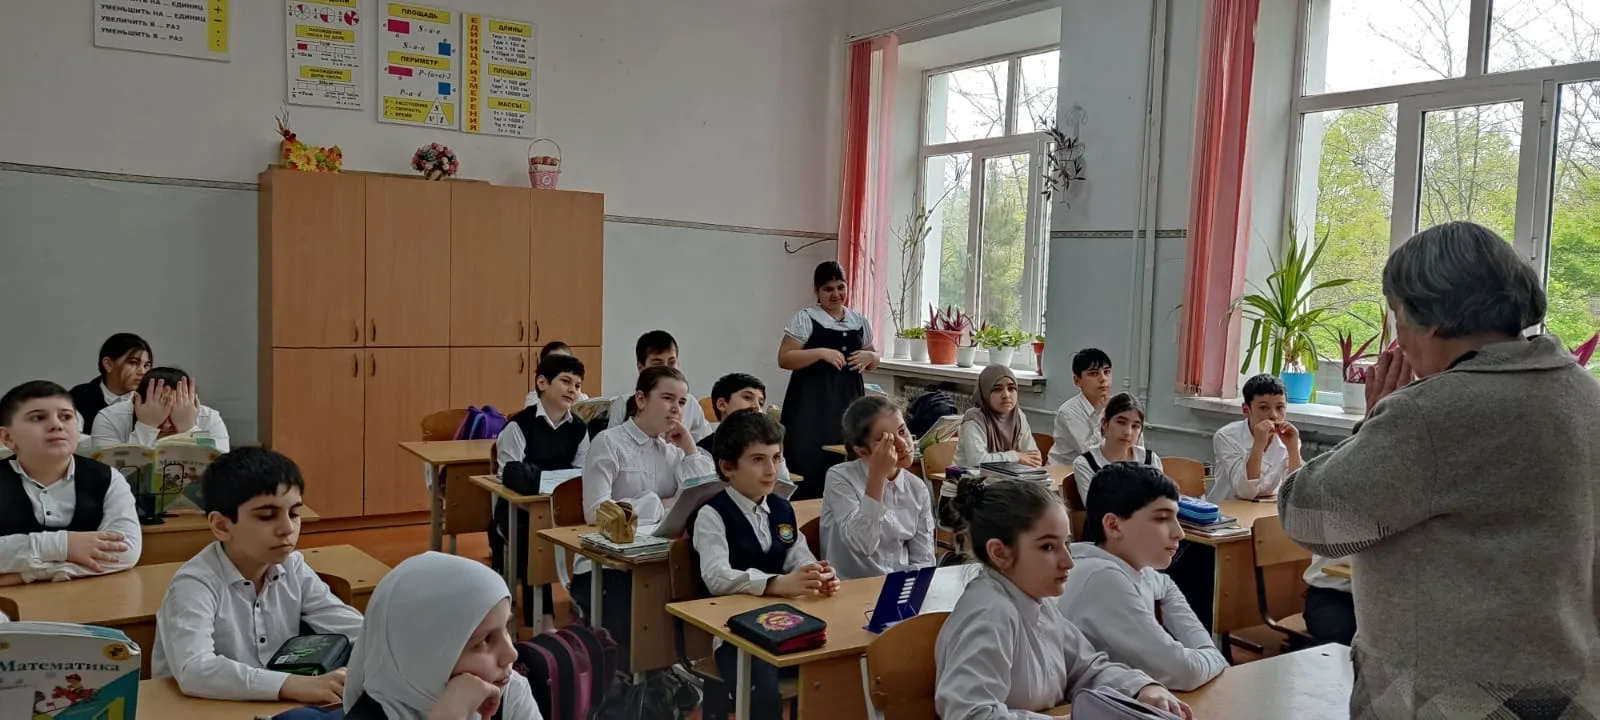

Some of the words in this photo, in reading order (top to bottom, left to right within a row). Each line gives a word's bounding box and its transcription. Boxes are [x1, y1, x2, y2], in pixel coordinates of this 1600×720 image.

[172, 2, 204, 10] ЕДИНИЦ
[101, 4, 150, 15] УМЕНЬШИТЬ
[174, 13, 206, 22] ЕДИНИЦ
[402, 8, 438, 19] ПЛОЩАДЬ
[101, 15, 148, 26] УВЕЛИЧИТЬ
[101, 27, 150, 38] УМЕНЬШИТЬ
[401, 56, 438, 65] ПЕРИМЕТР
[494, 68, 526, 76] ПЛОЩАДИ
[470, 69, 478, 130] ИЗМЕРЕНИЯ
[0, 661, 120, 672] Математика
